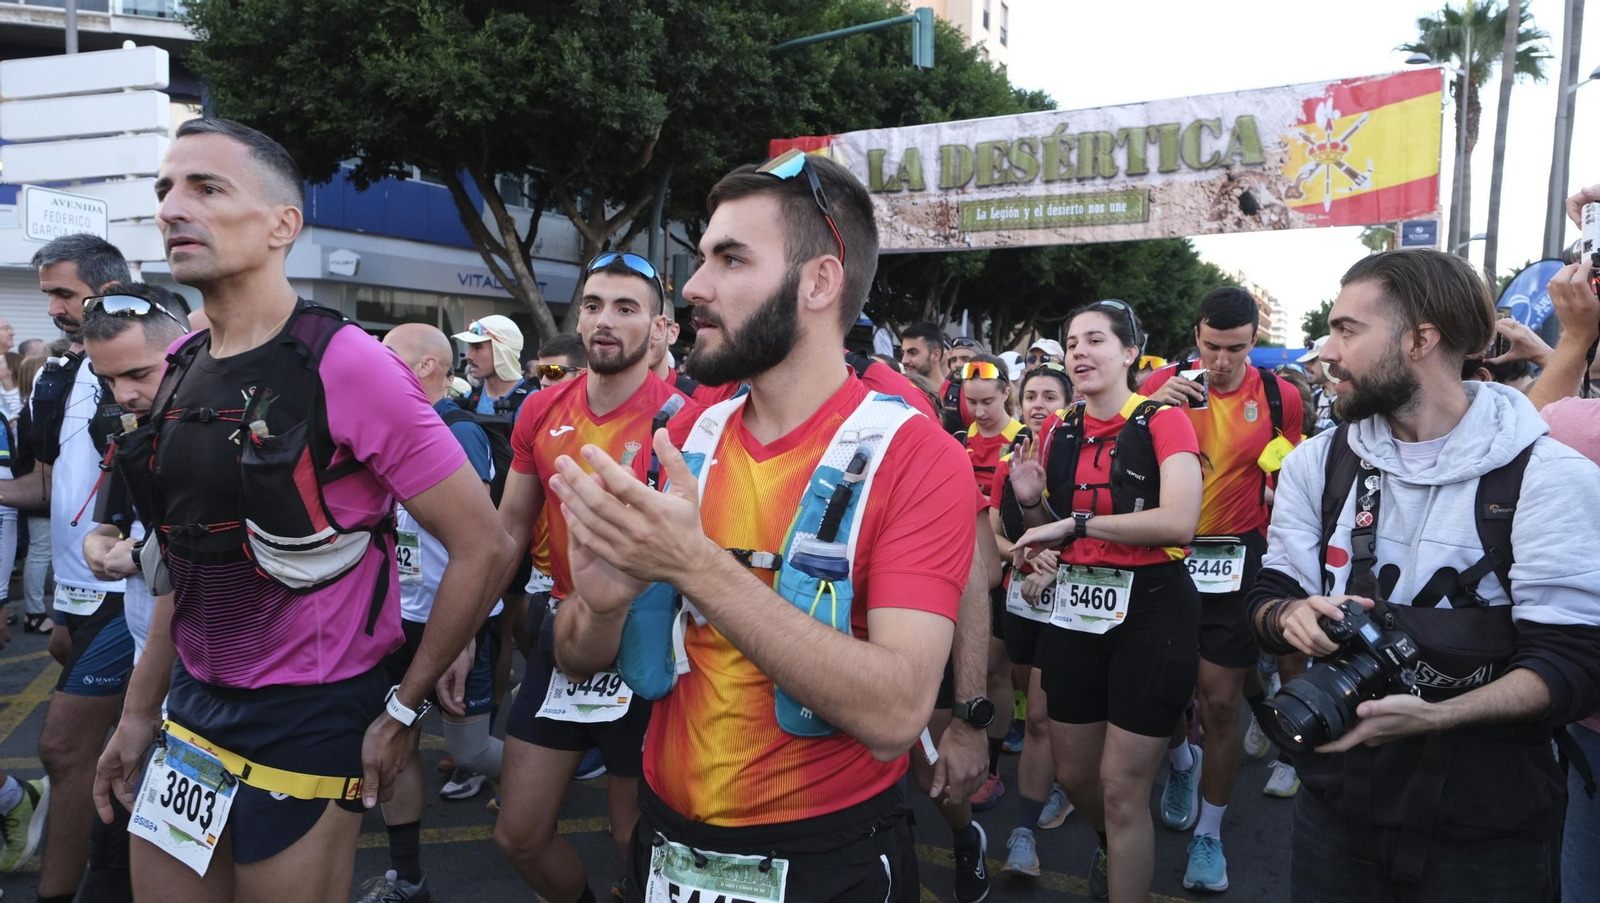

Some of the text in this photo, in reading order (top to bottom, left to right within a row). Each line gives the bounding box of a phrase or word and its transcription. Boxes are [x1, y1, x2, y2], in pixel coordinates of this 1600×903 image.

[867, 113, 1267, 193] LA DESÉRTICA
[51, 198, 104, 214] AVENIDA
[976, 201, 1128, 222] La Legión y el desierto nos une
[43, 209, 92, 229] FEDERICO
[457, 272, 548, 295] VITALT
[1187, 559, 1233, 576] 5446
[1069, 584, 1118, 612] 5460
[159, 770, 217, 830] 3803
[133, 814, 154, 832] asisa
